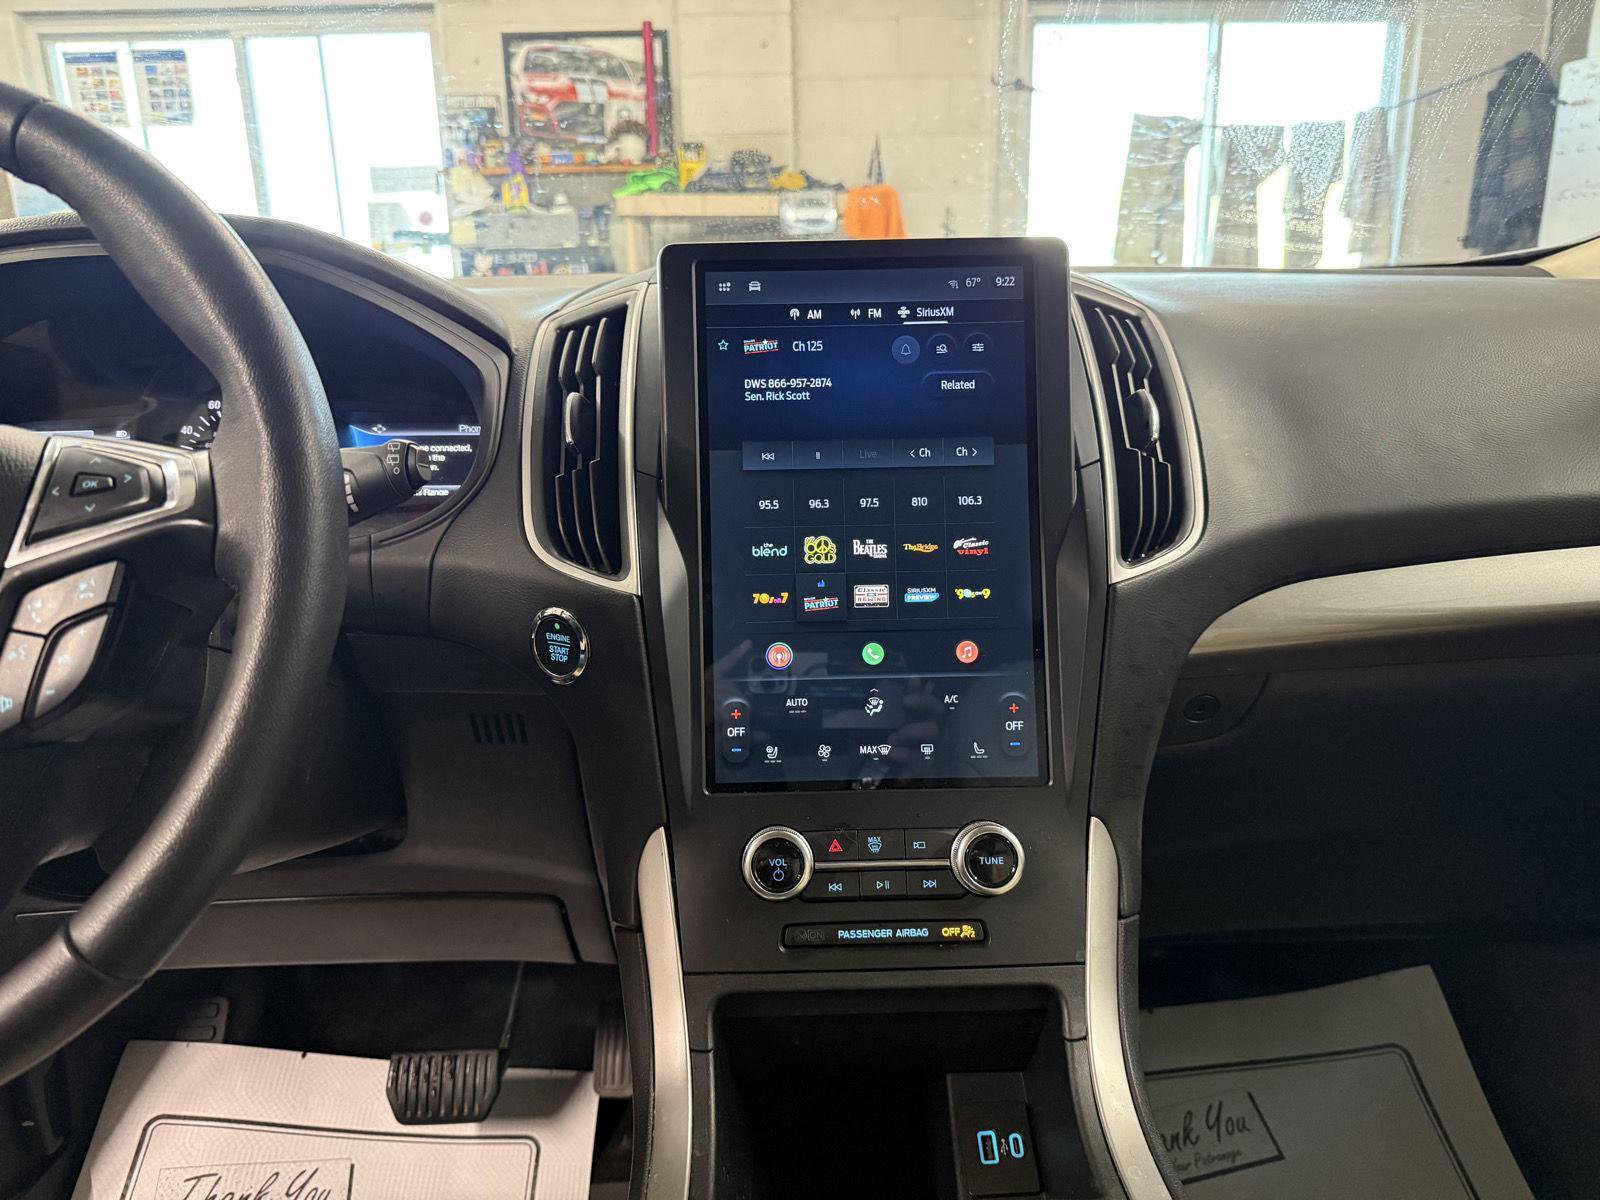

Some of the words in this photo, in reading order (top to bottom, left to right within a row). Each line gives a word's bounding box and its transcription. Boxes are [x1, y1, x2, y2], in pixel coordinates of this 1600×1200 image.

[996, 276, 1015, 287] 9:22
[807, 309, 822, 319] AM
[868, 308, 882, 318] FM
[916, 306, 954, 317] SiriusXM
[743, 341, 778, 353] PATRIOT
[792, 341, 805, 351] Ch
[807, 341, 823, 351] 125
[744, 379, 766, 389] DWS
[768, 378, 832, 388] 866-957-2874
[941, 379, 976, 390] Related
[744, 392, 764, 401] Sen.
[766, 391, 784, 401] Rick
[786, 391, 810, 401] Scott
[208, 400, 221, 409] 60
[181, 425, 193, 434] 40
[430, 444, 472, 452] connected,
[919, 447, 931, 458] Ch
[956, 446, 968, 456] Ch
[859, 450, 878, 459] Live
[82, 480, 99, 489] OK
[423, 488, 449, 497] Range
[758, 500, 779, 510] 95.5
[808, 499, 830, 509] 96.3
[860, 498, 879, 508] 97.5
[911, 497, 928, 506] 810
[957, 495, 983, 505] 106.3
[752, 545, 788, 557] blend
[853, 539, 888, 557] BEATLES
[957, 547, 989, 556] vinyl
[804, 553, 837, 564] GOLD
[804, 599, 839, 611] PATRIOT
[545, 632, 571, 643] ENGINE
[549, 645, 569, 655] START
[550, 653, 568, 662] STOP
[785, 698, 808, 707] AUTO
[944, 695, 959, 703] A/C
[1005, 721, 1024, 731] OFF
[727, 727, 746, 737] OFF
[859, 745, 878, 754] MAX
[769, 858, 787, 867] VOL
[979, 856, 1004, 865] TUNE
[838, 928, 893, 939] PASSENGER
[896, 927, 929, 938] AIRBAG
[942, 927, 960, 937] OFF
[1206, 1101, 1250, 1142] You
